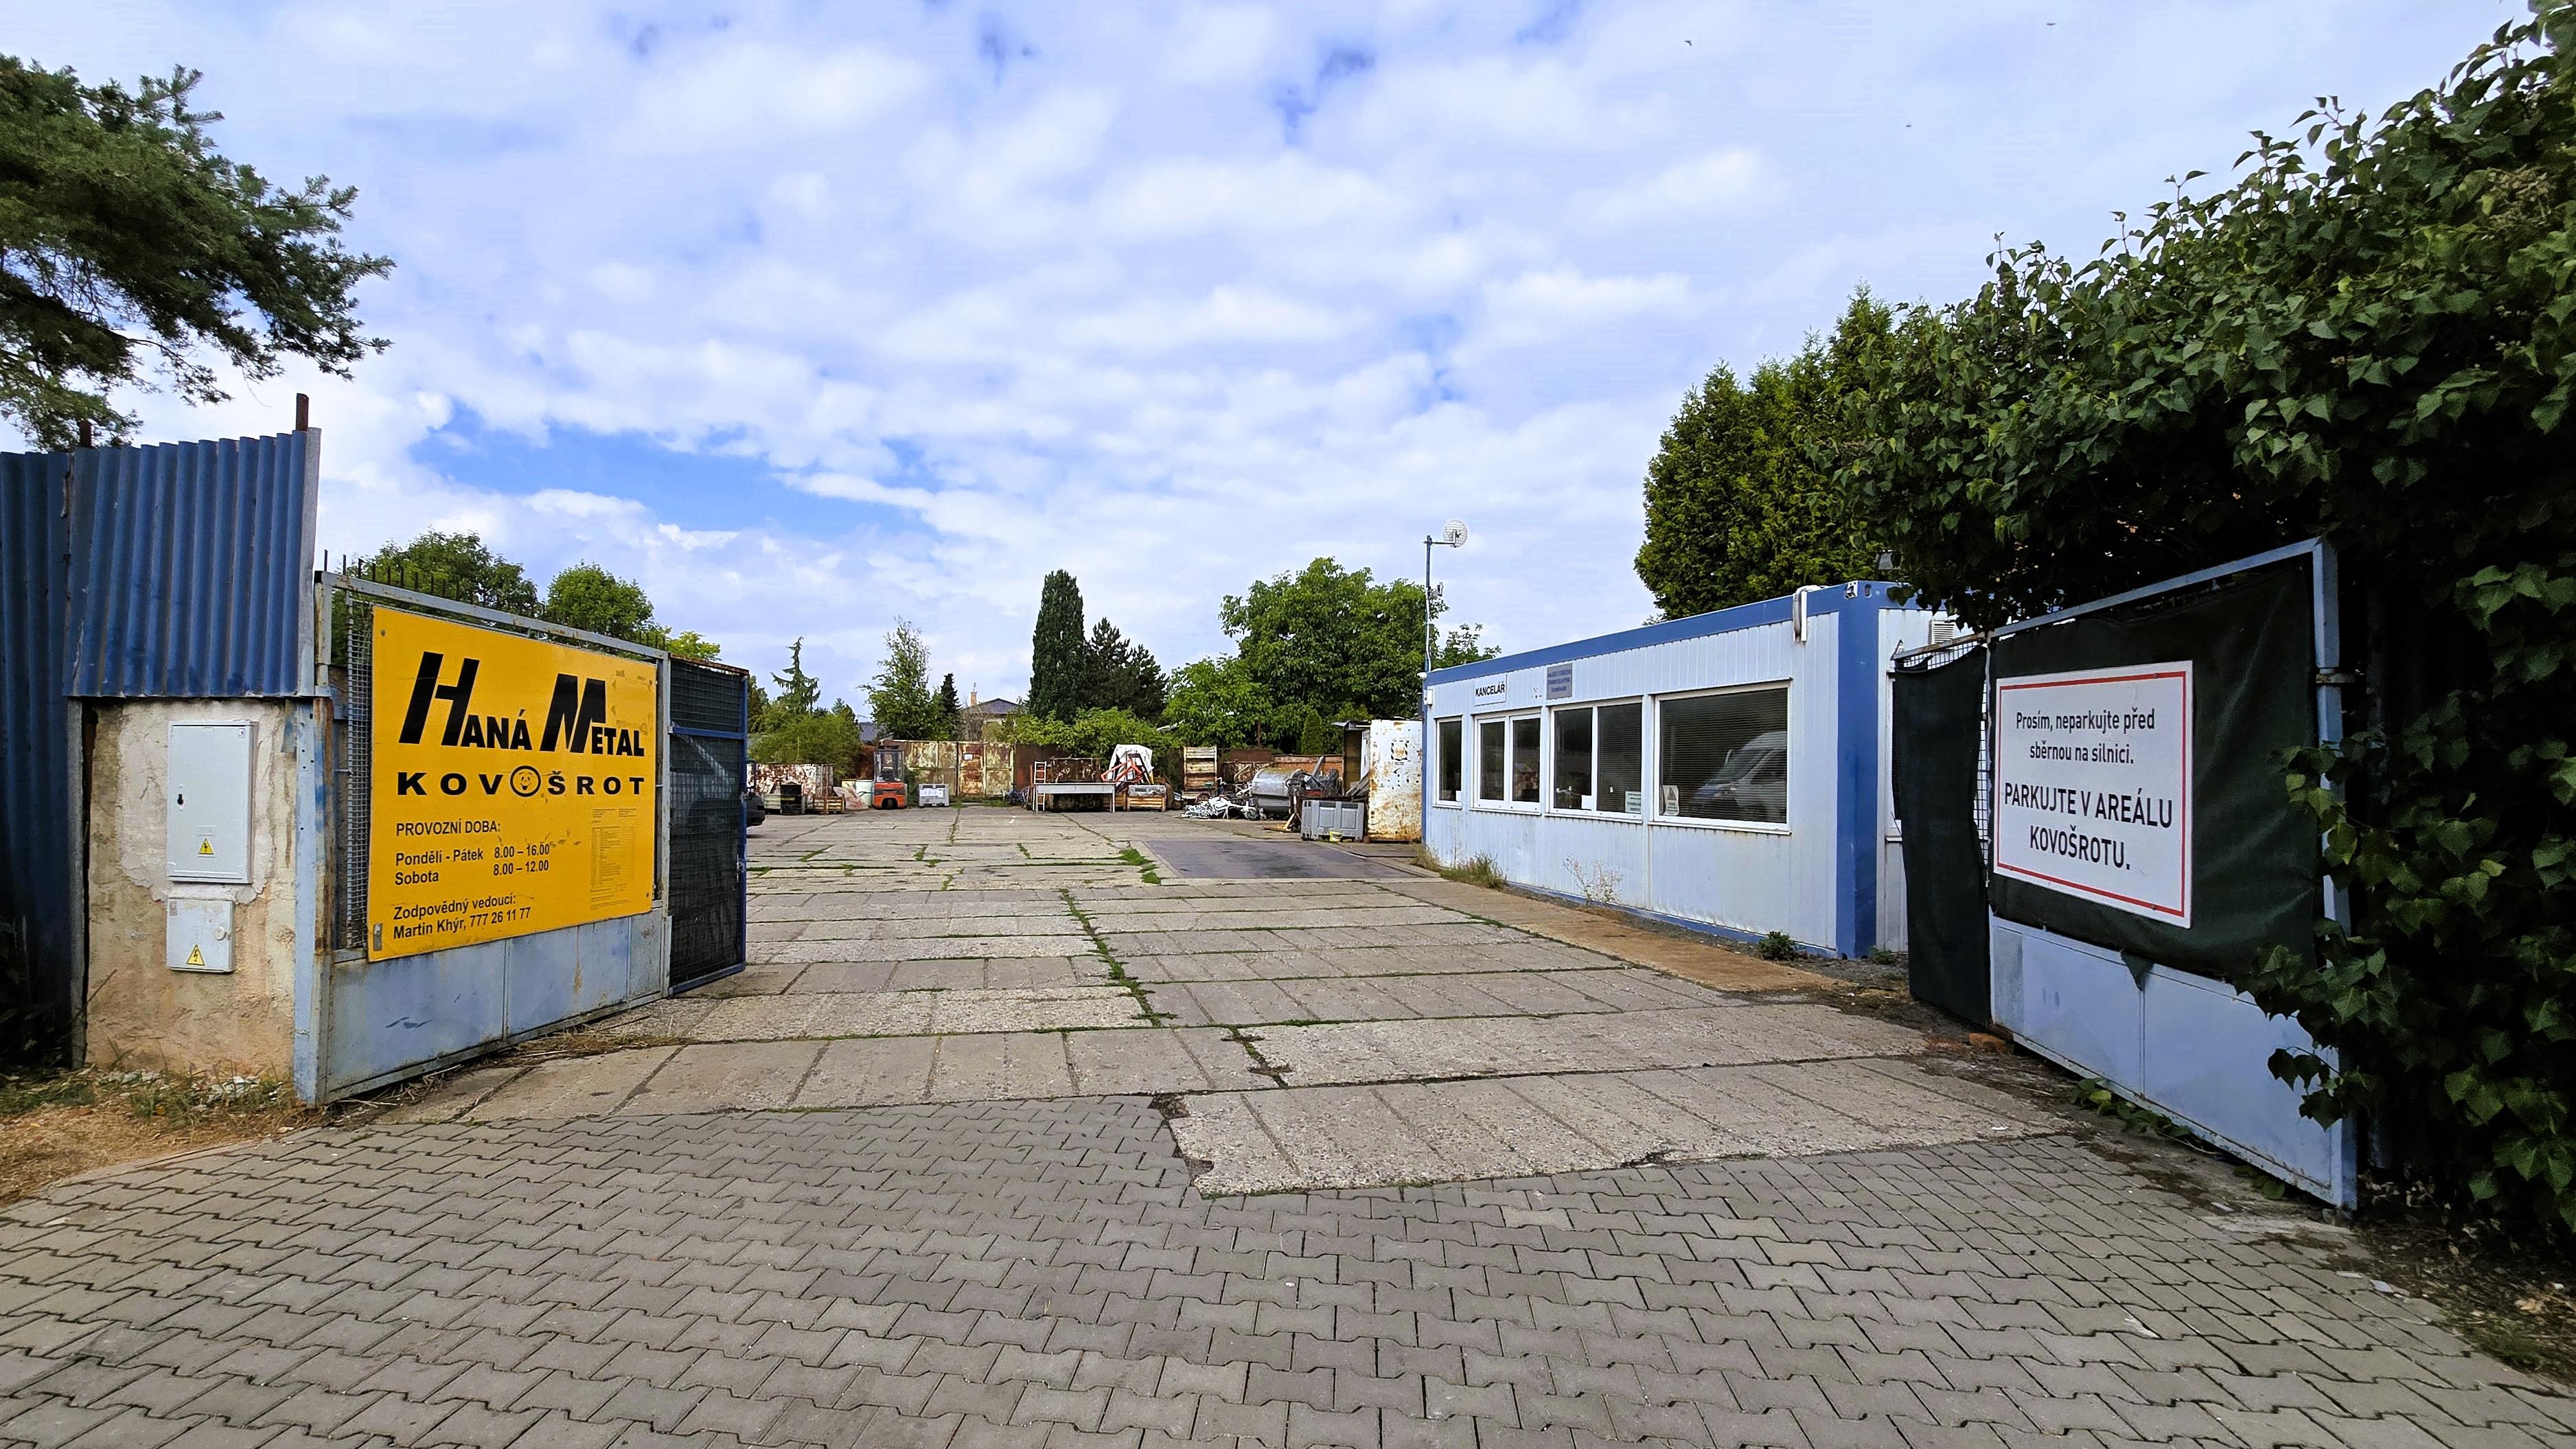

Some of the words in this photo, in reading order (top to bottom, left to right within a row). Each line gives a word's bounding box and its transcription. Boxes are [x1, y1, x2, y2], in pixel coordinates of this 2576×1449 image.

[1475, 681, 1505, 697] KANCELÁŘ
[2016, 710, 2053, 732] Prosím,
[2056, 710, 2119, 734] neparkujte
[2124, 707, 2155, 734] před
[2029, 740, 2071, 760] sběrnou
[2075, 747, 2088, 761] na
[2091, 743, 2134, 764] silnici.
[2005, 782, 2076, 815] PARKUJTE
[2080, 790, 2091, 816] V
[2095, 788, 2172, 828] AREÁLU
[396, 818, 461, 836] PROVOZNÍ
[465, 820, 501, 833] DOBA:
[395, 850, 442, 866] Pondělí
[453, 848, 483, 862] Pátek
[494, 846, 515, 858] 8.00
[526, 844, 550, 856] 16.00
[2029, 824, 2130, 870] KOVOŠROTU.
[395, 871, 439, 885] Sobota
[493, 863, 514, 876] 8.00
[525, 860, 549, 872] 12.00
[393, 899, 469, 920] Zodpovědný
[472, 892, 516, 909] vedoucí:
[393, 923, 433, 939] Martin
[437, 918, 467, 934] Khýr,
[470, 914, 489, 927] 777
[491, 912, 503, 925] 26
[506, 909, 516, 923] 11
[520, 907, 531, 920] 77
